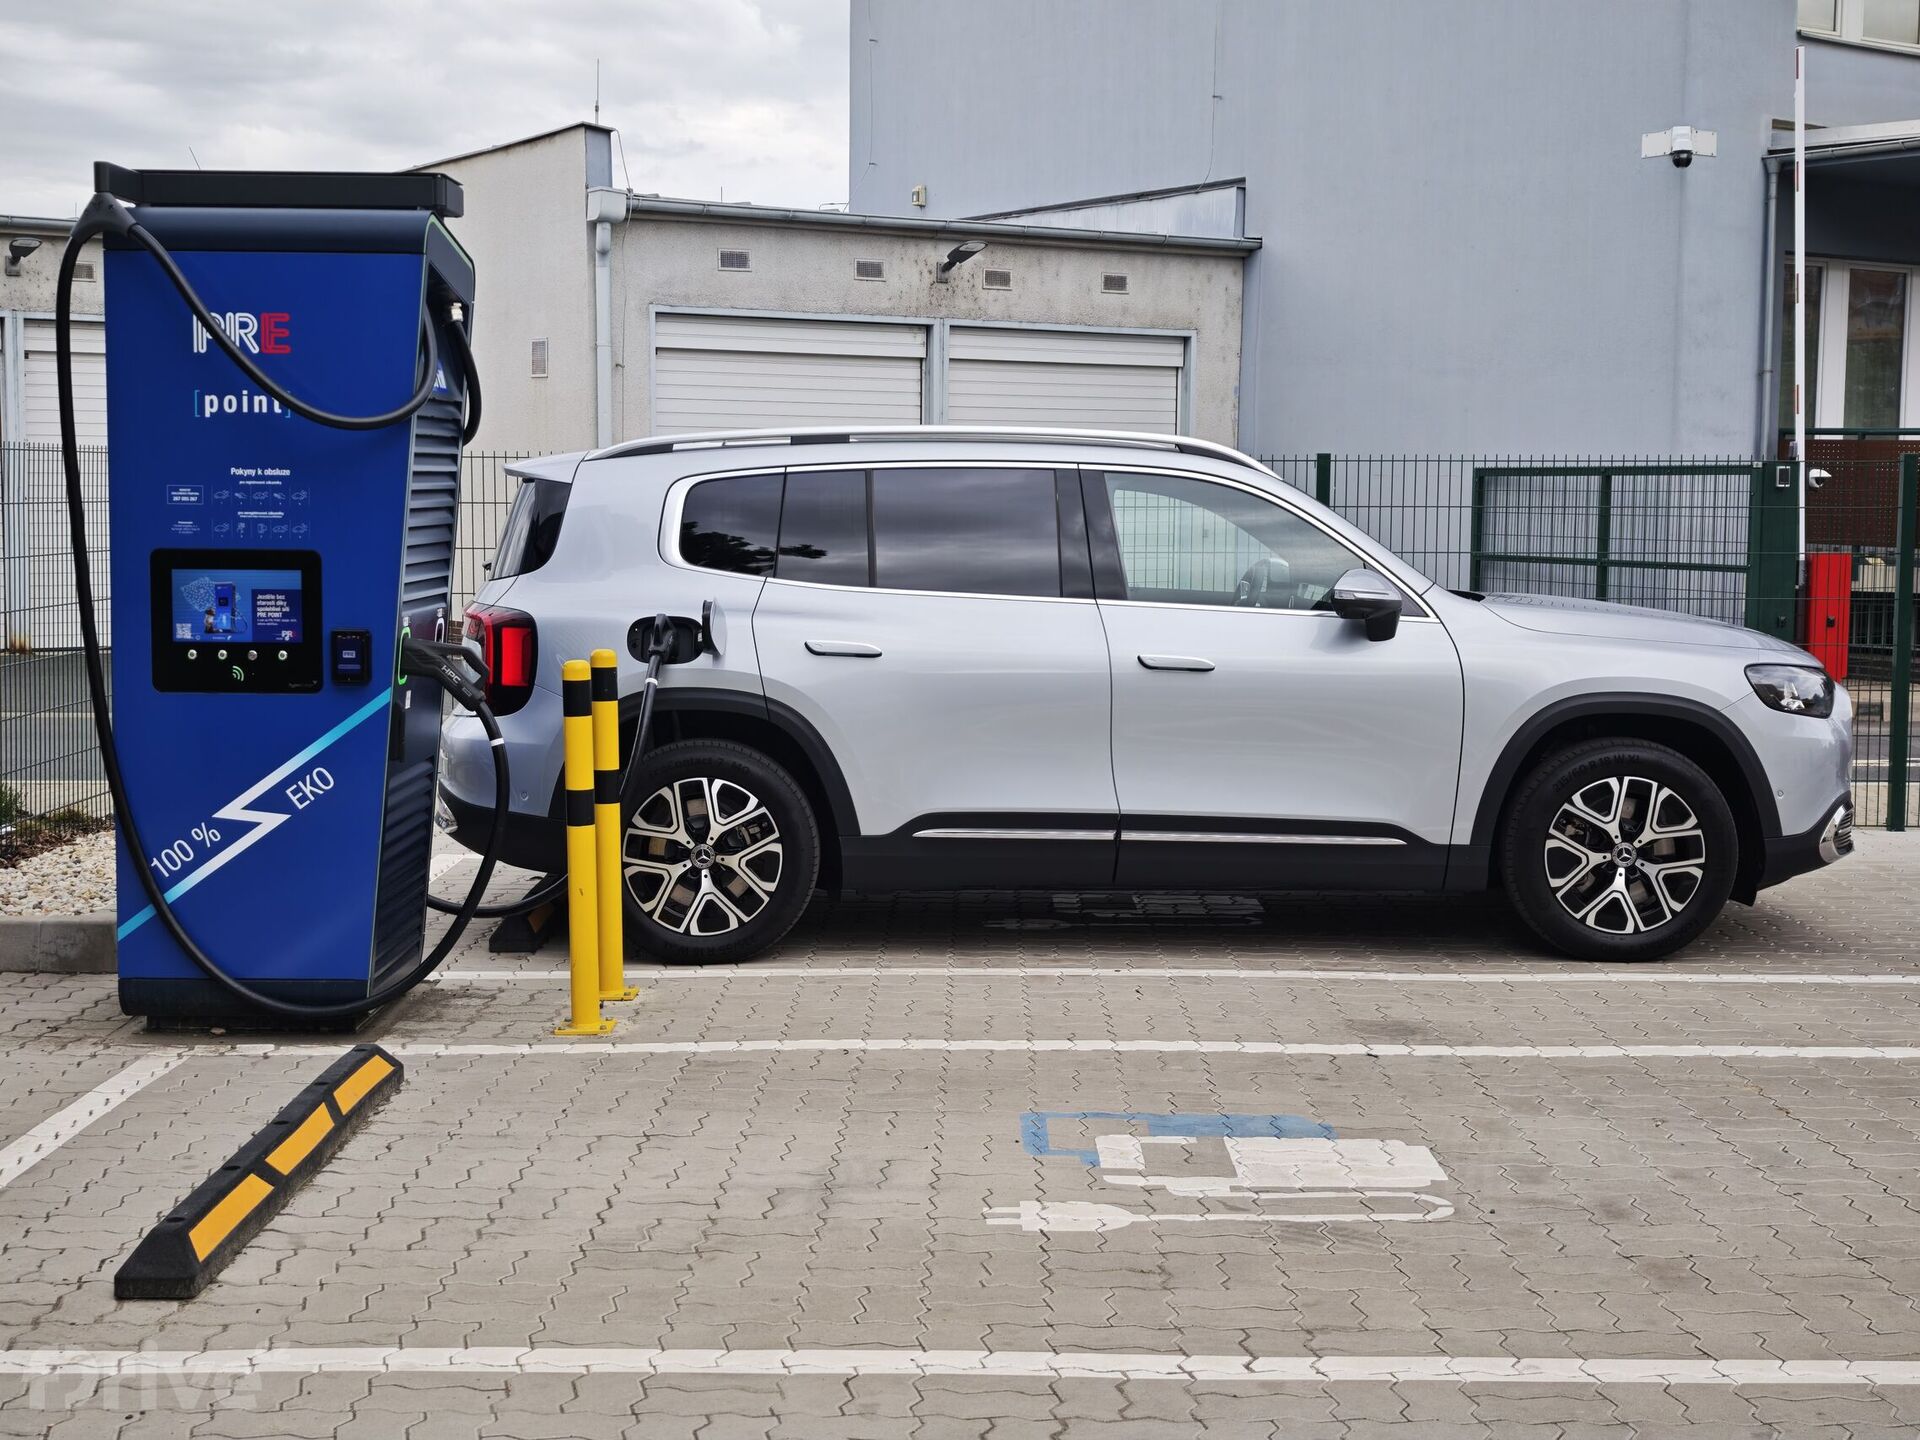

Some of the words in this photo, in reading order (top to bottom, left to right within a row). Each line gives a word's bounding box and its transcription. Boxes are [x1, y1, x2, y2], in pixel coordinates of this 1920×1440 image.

[192, 312, 291, 354] PRE
[230, 467, 256, 477] Pokyny
[264, 468, 291, 476] obsluze
[441, 665, 462, 684] HPC
[150, 838, 194, 878] 100
[191, 821, 221, 848] %
[285, 766, 335, 810] EKO
